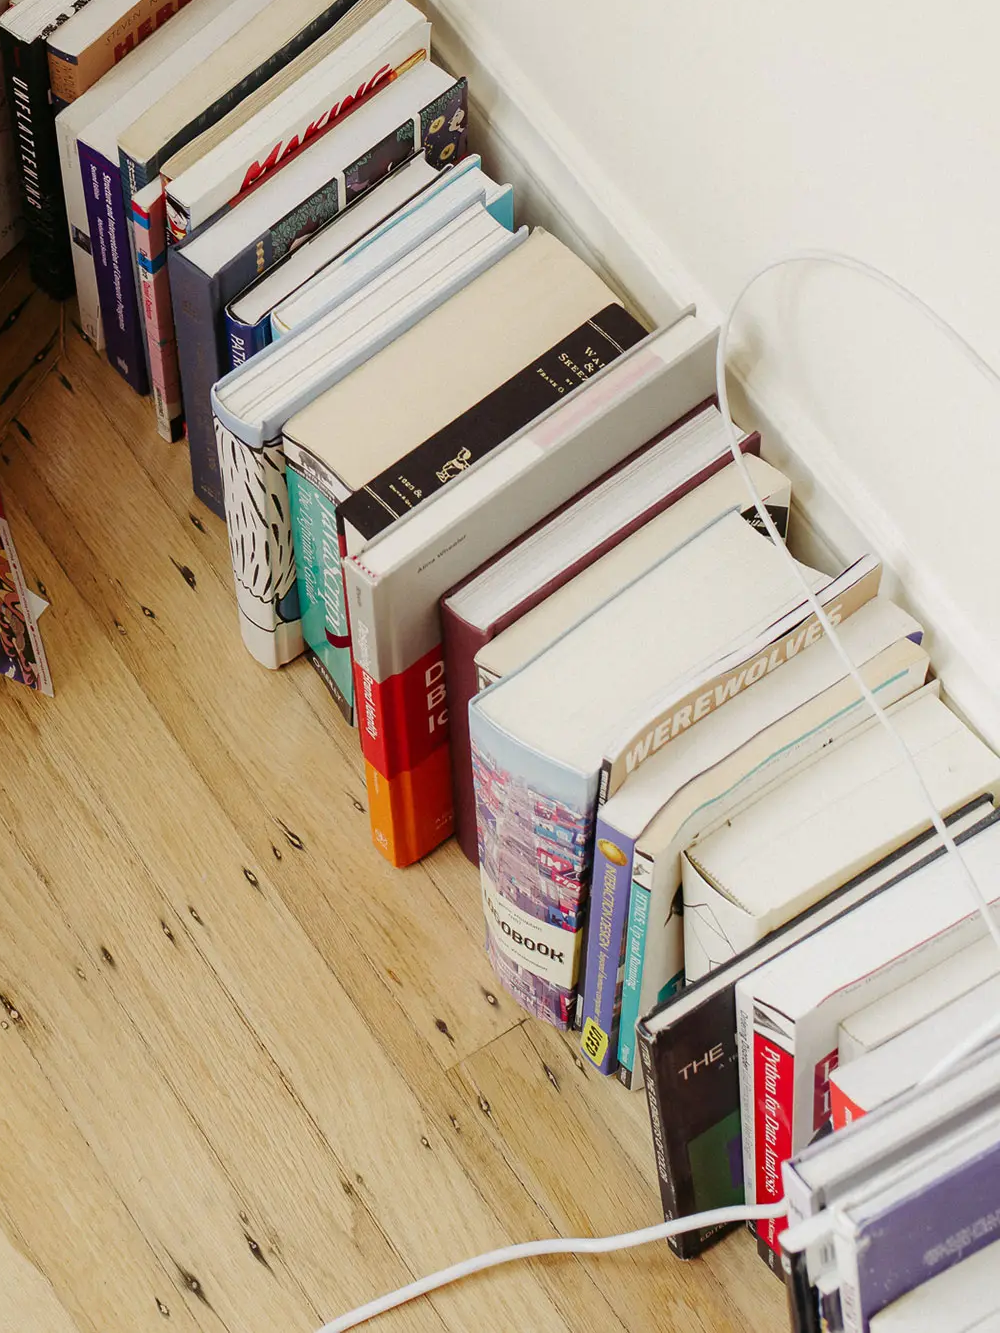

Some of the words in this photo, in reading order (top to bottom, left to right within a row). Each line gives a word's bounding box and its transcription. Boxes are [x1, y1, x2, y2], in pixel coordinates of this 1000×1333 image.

[105, 9, 142, 46] STEVEN
[12, 75, 43, 210] UNFLATTENING
[103, 170, 114, 207] Structure
[108, 216, 121, 267] Interpretation
[113, 268, 124, 303] Computer
[584, 362, 595, 373] &
[297, 483, 310, 508] The
[299, 507, 316, 568] Definitive
[313, 492, 346, 636] JavaScript
[304, 565, 318, 606] Guide
[363, 669, 374, 702] Brand
[625, 603, 844, 775] WEREWOLVES
[365, 700, 378, 741] Identity
[601, 863, 617, 917] INTERACTION
[633, 890, 648, 925] HTML5:
[597, 916, 611, 951] DESIGN
[629, 937, 642, 956] and
[631, 924, 643, 941] Up
[625, 955, 641, 991] Running
[584, 1024, 604, 1058] USED
[678, 1042, 725, 1082] THE
[762, 1046, 780, 1096] Python
[765, 1093, 780, 1118] for
[764, 1114, 778, 1145] Data
[762, 1142, 778, 1196] Analysis
